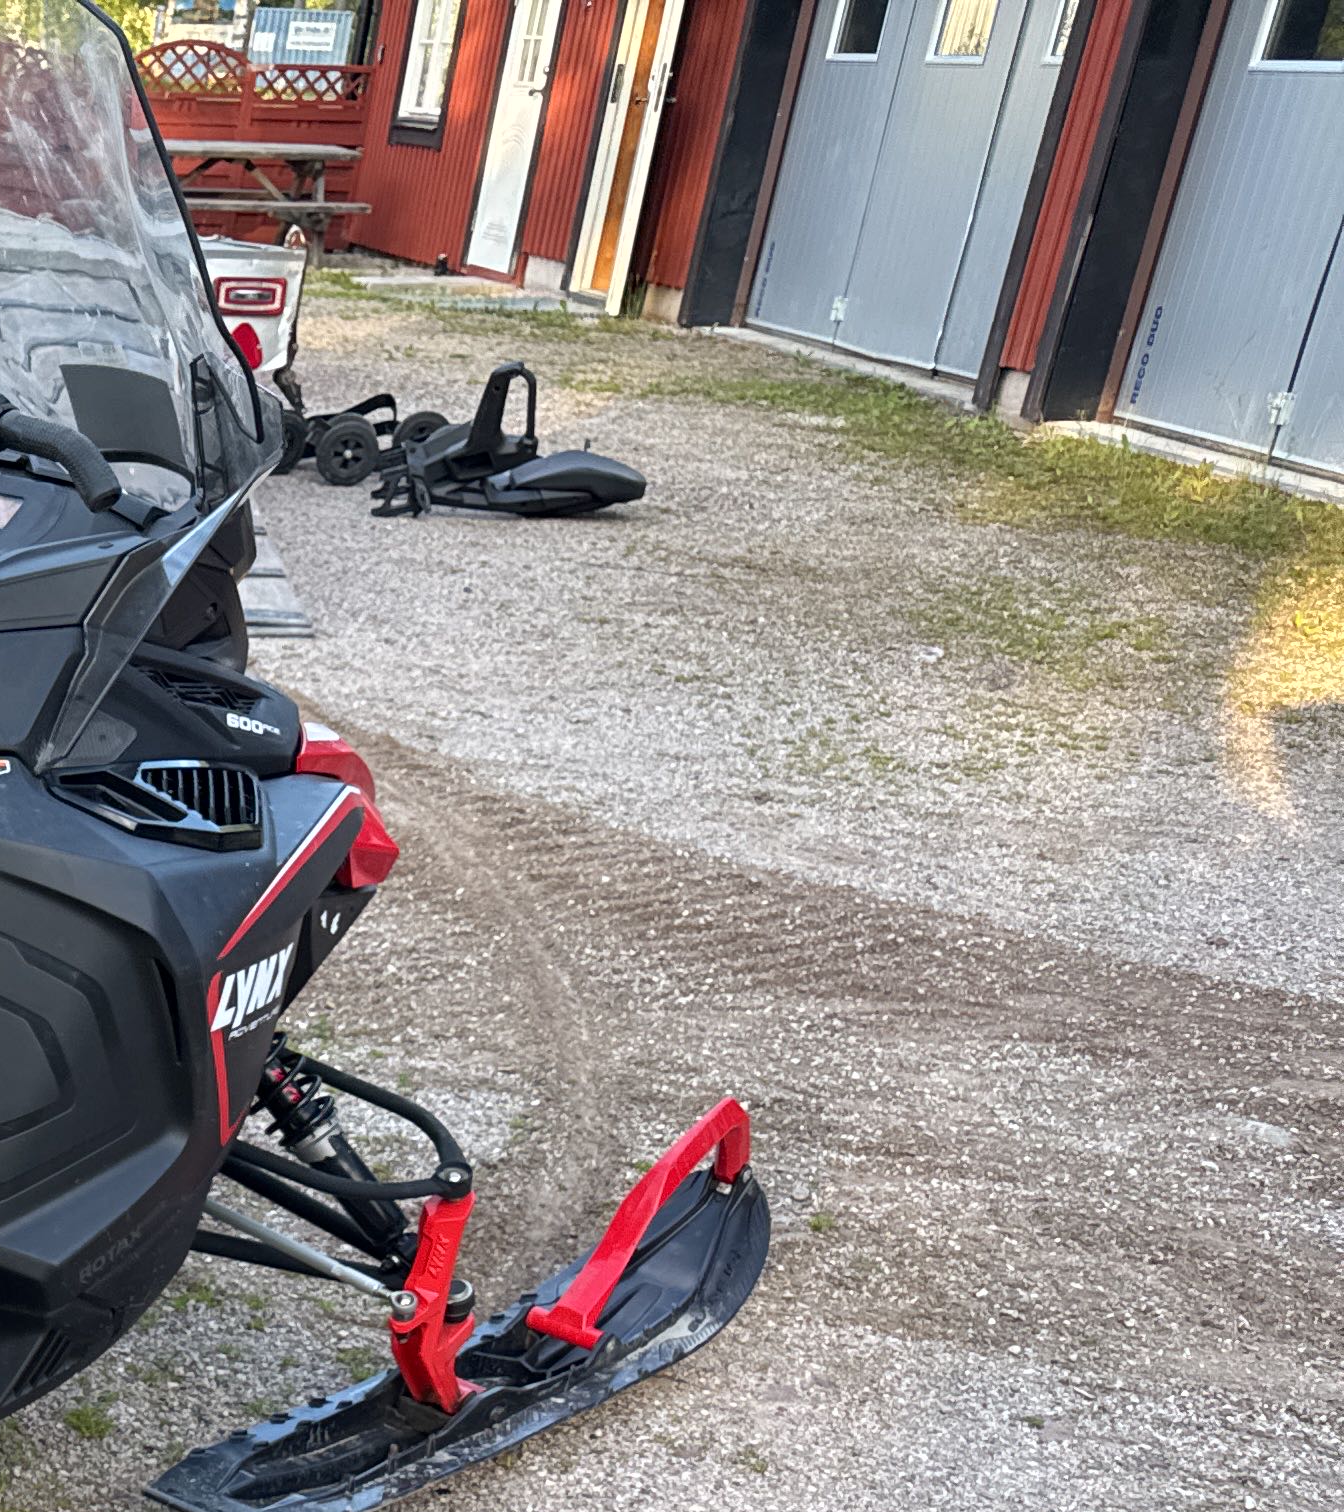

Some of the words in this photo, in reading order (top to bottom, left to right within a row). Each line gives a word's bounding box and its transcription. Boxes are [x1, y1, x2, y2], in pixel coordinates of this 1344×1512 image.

[1130, 352, 1150, 405] RECO
[1146, 304, 1163, 347] DUO
[226, 712, 264, 735] 600
[210, 942, 295, 1032] LYNX
